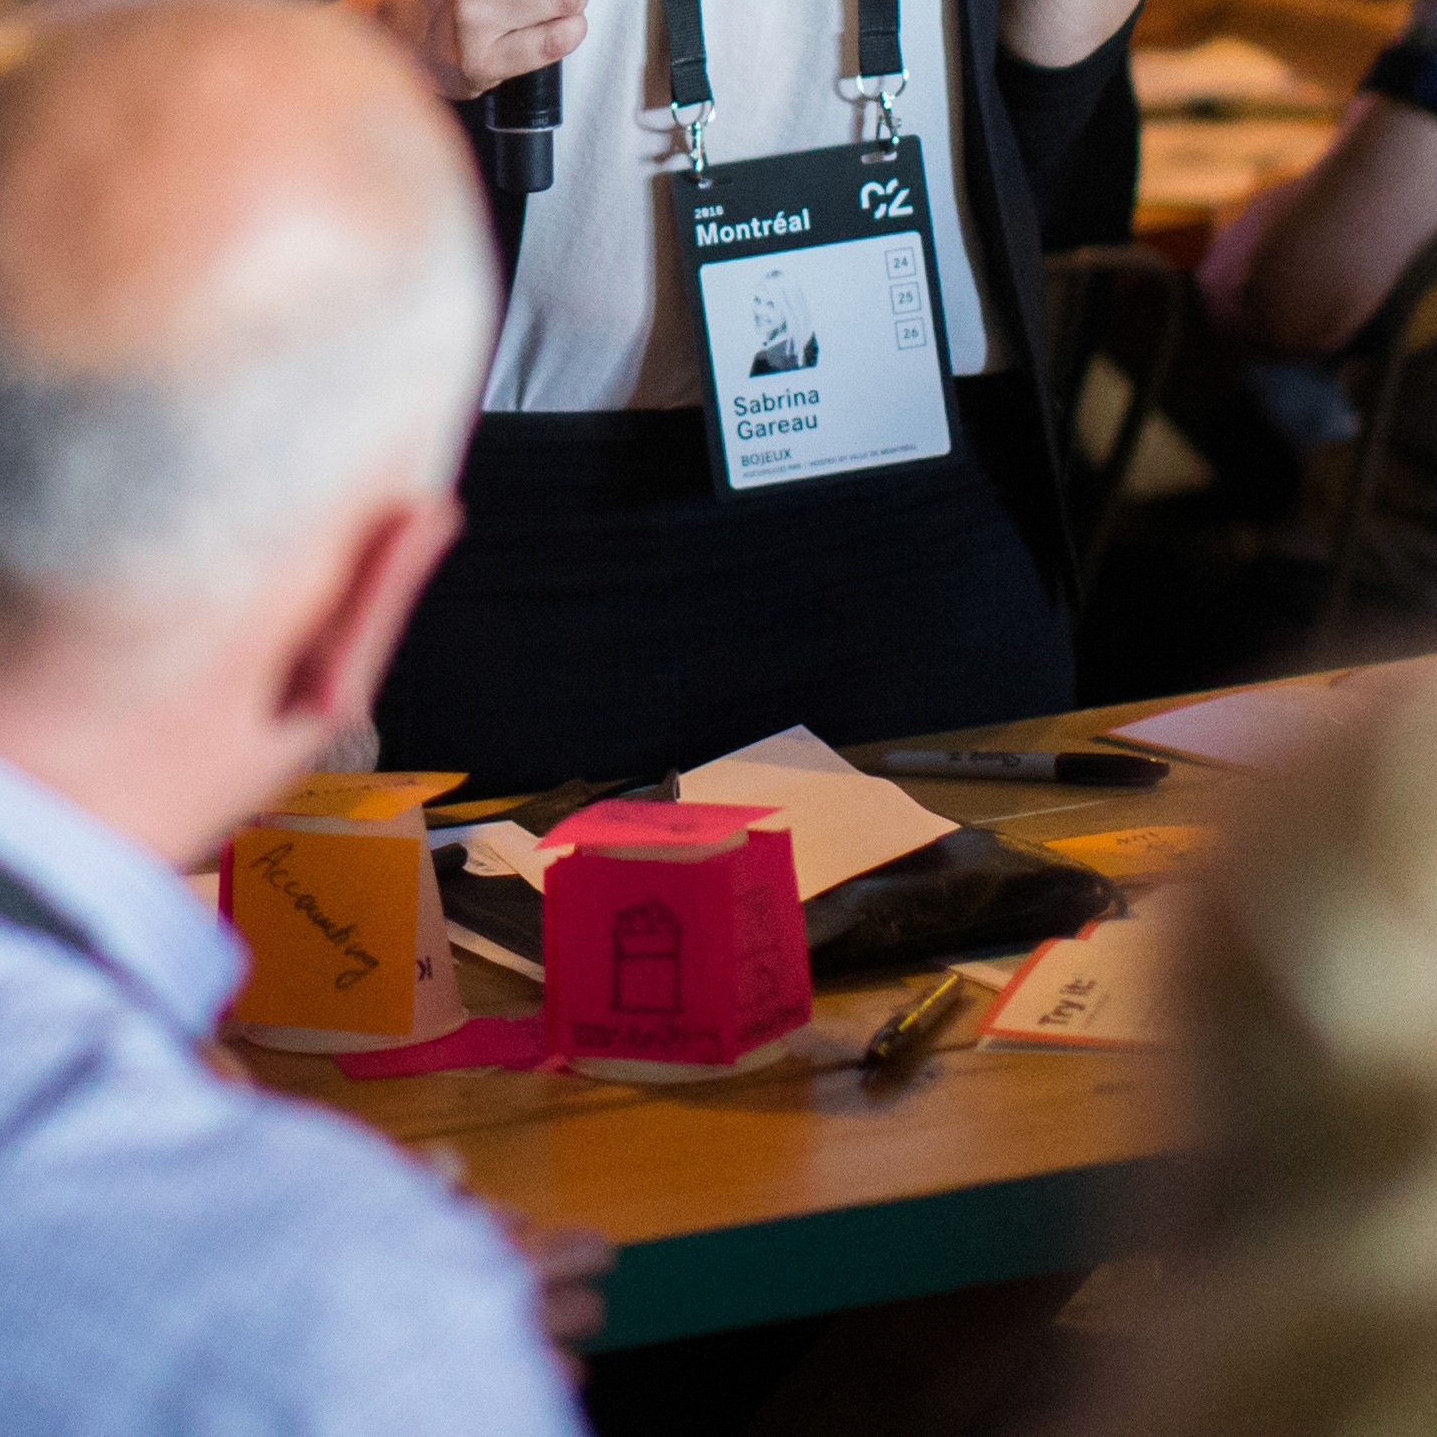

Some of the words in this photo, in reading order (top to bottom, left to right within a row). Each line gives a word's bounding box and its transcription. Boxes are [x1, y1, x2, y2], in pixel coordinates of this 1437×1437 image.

[696, 208, 811, 247] Montréal
[893, 256, 909, 269] 24
[898, 291, 914, 304] 25
[903, 327, 919, 340] 26
[734, 388, 819, 416] Sabrina
[737, 414, 818, 440] Gareau
